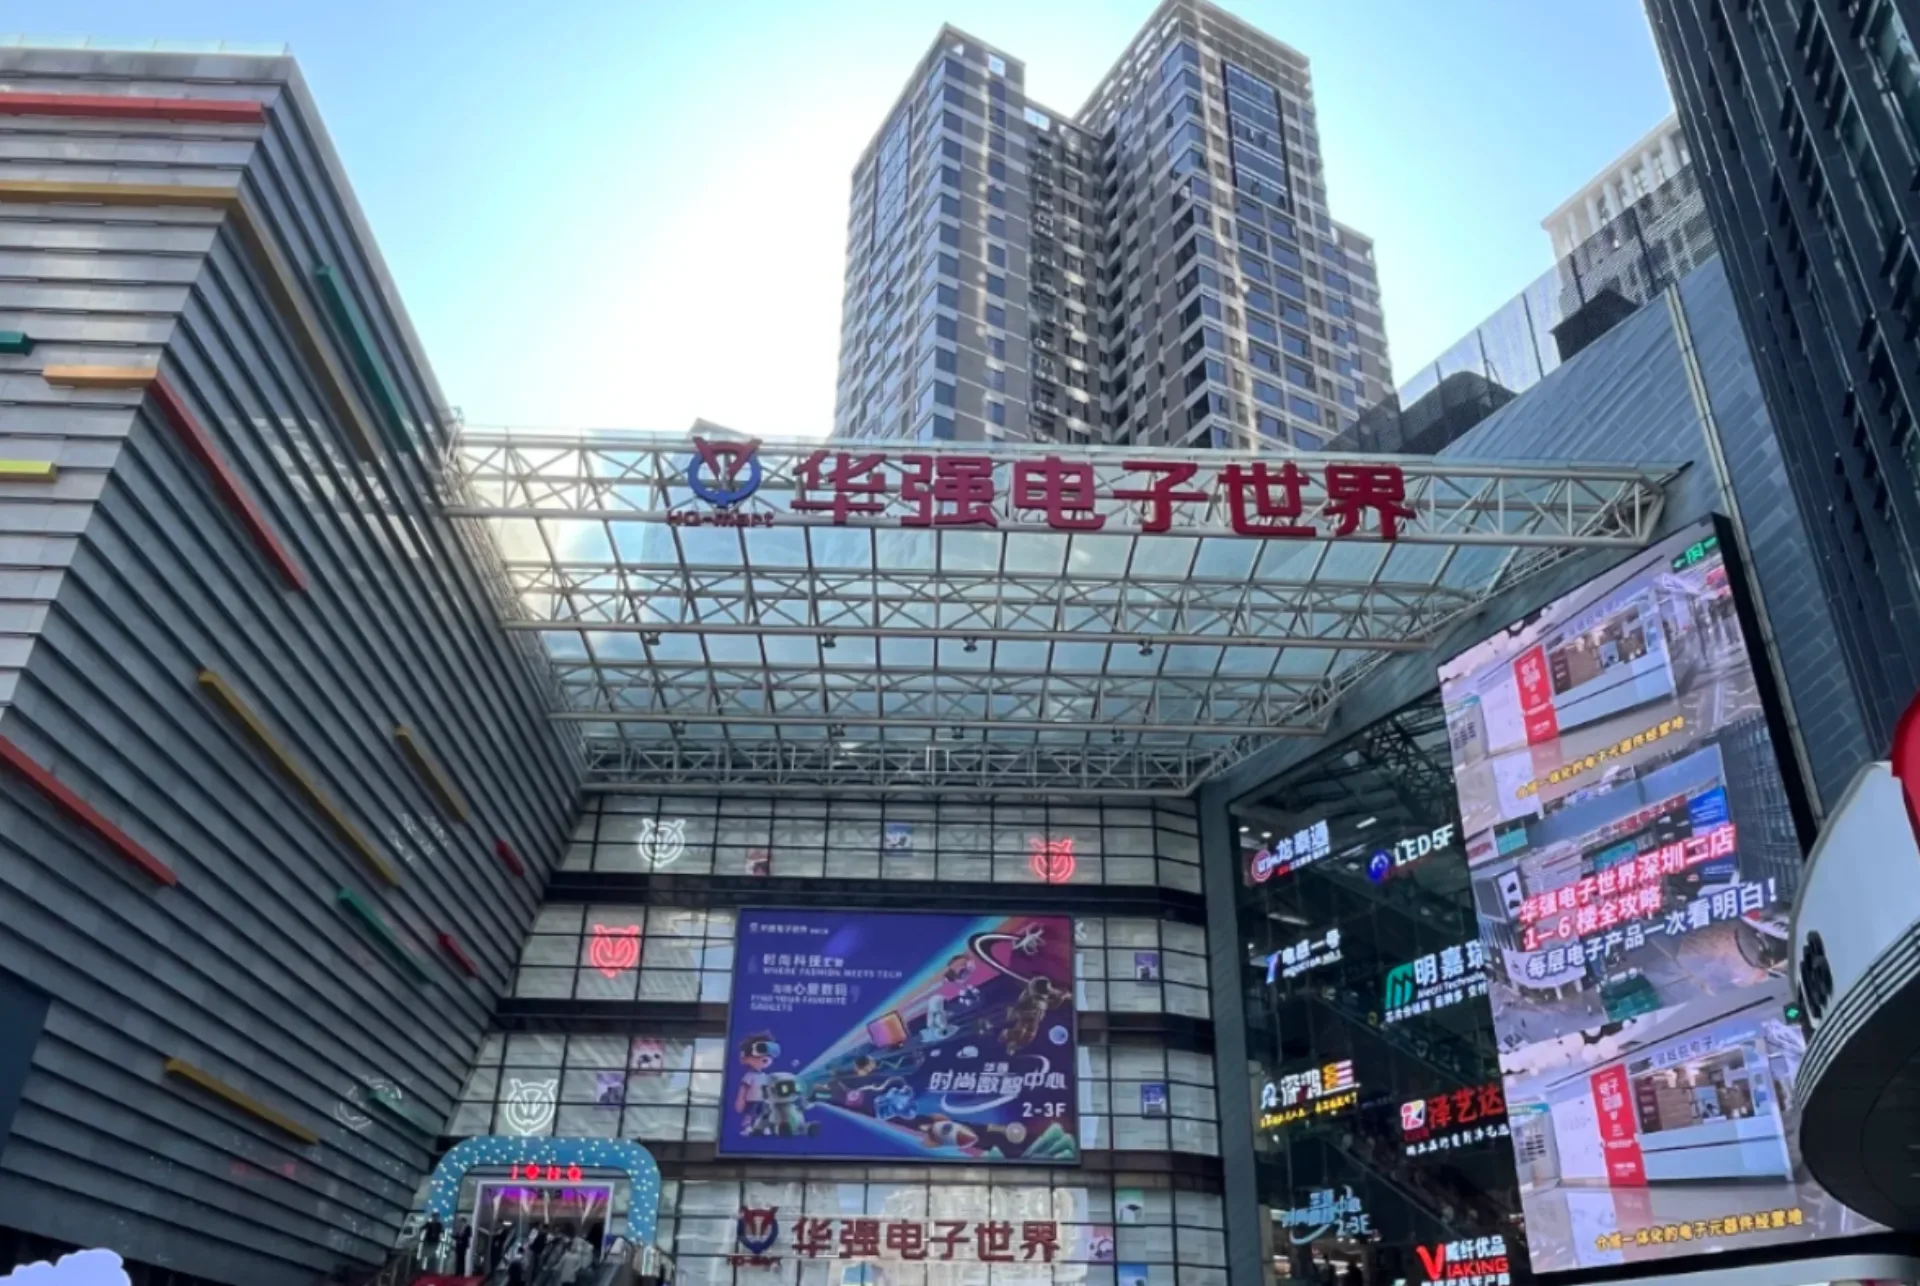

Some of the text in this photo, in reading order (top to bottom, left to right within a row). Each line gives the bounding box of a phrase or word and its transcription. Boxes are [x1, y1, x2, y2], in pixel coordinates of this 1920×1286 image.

[790, 449, 1417, 540] 华强电子世界
[1520, 825, 1735, 923] 华强电子世界深圳二店
[799, 968, 841, 977] FASHION
[1022, 1102, 1067, 1117] 2-3F
[1428, 1083, 1505, 1129] 泽艺达
[791, 1217, 1061, 1263] 华强电子世界
